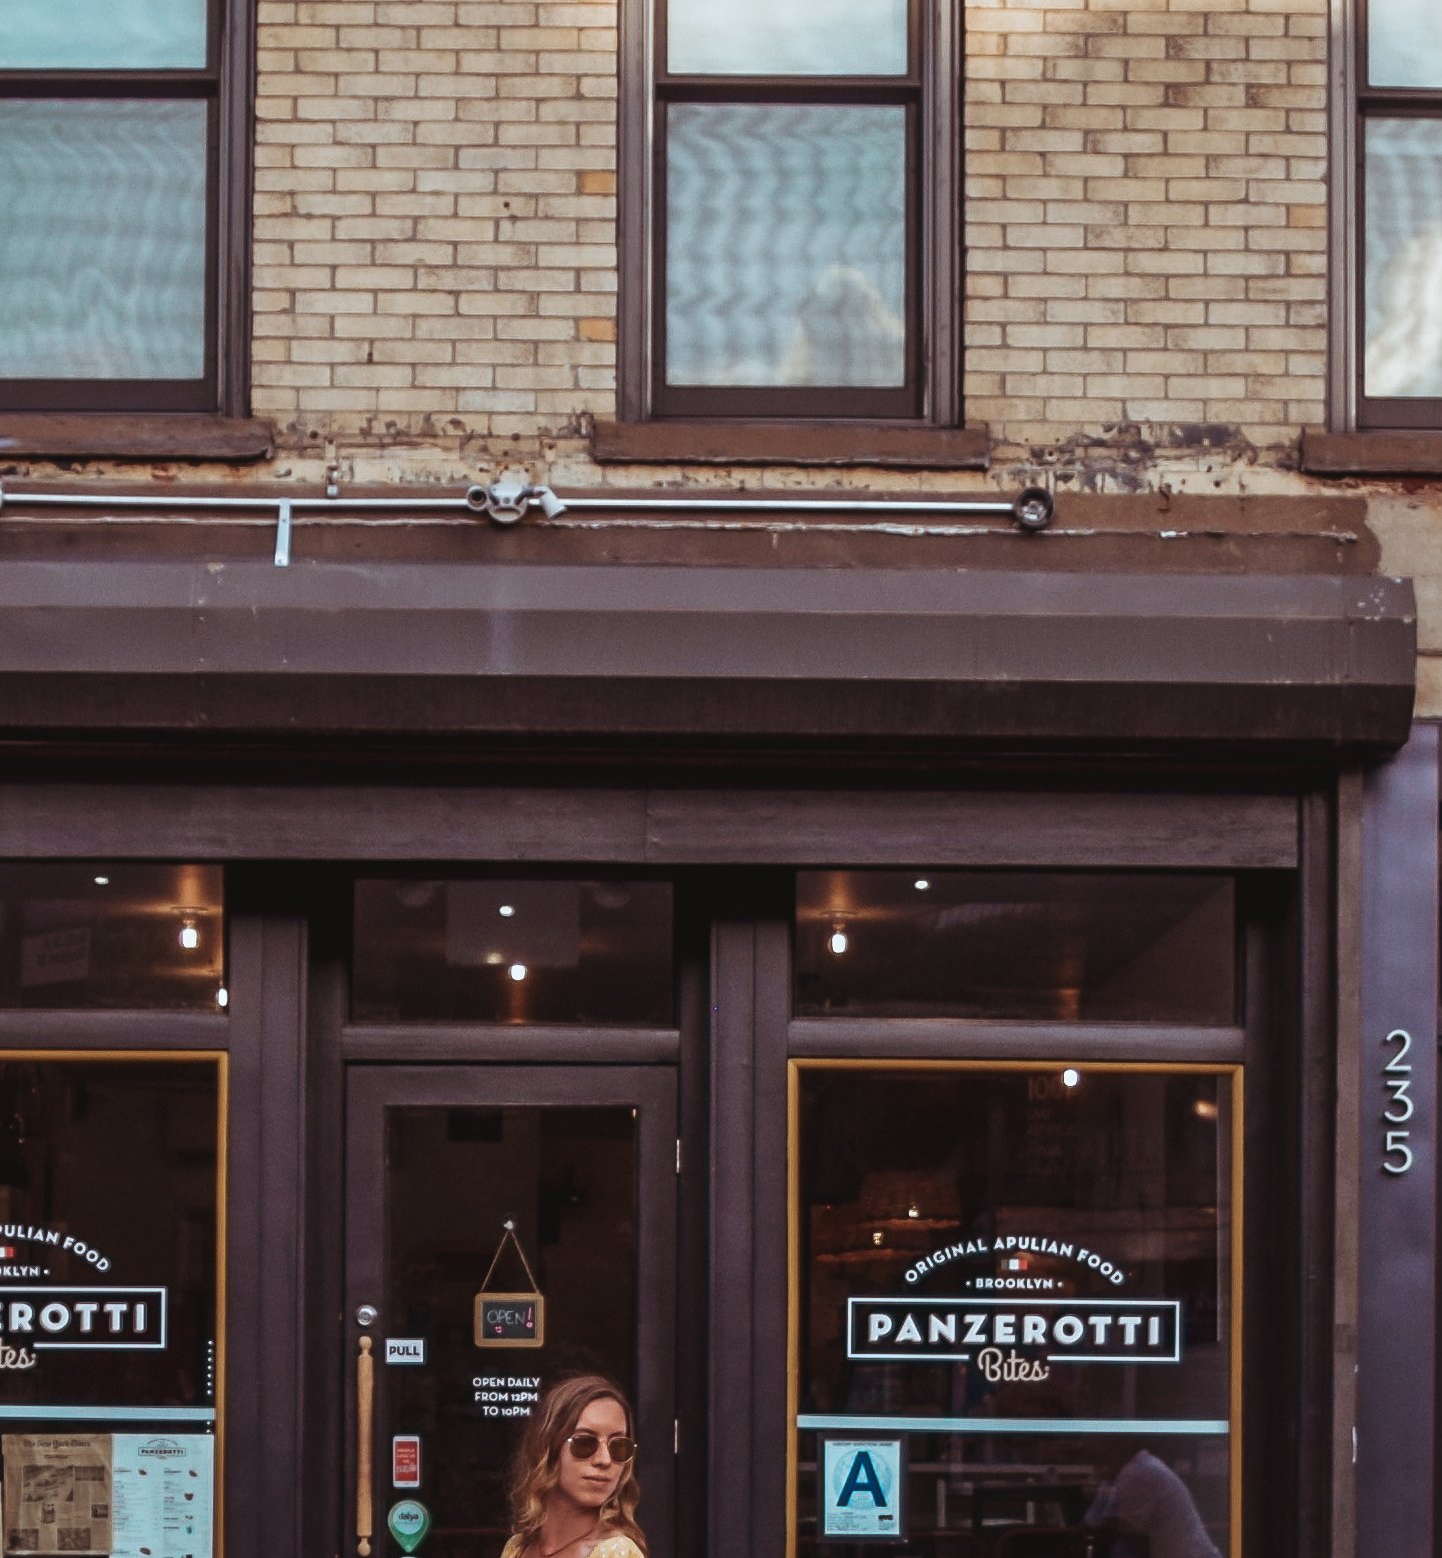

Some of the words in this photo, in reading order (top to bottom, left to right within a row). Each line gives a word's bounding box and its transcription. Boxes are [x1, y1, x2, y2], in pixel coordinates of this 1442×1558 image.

[1383, 1028, 1414, 1174] 235
[63, 1236, 111, 1272] FOOD
[905, 1237, 988, 1285] ORIGINAL
[995, 1236, 1072, 1257] APULIAN
[1076, 1248, 1126, 1286] FOOD
[976, 1278, 1053, 1290] BROOKLYN
[868, 1313, 1161, 1346] PANZEROTTI
[389, 1346, 420, 1356] PULL
[977, 1347, 1050, 1382] Bites
[472, 1377, 505, 1387] OPEN
[507, 1377, 540, 1387] DAILY
[474, 1392, 508, 1402] FROM
[510, 1392, 538, 1402] 12PM
[482, 1406, 499, 1416] TO
[501, 1406, 530, 1416] 10PM
[836, 1451, 887, 1507] A
